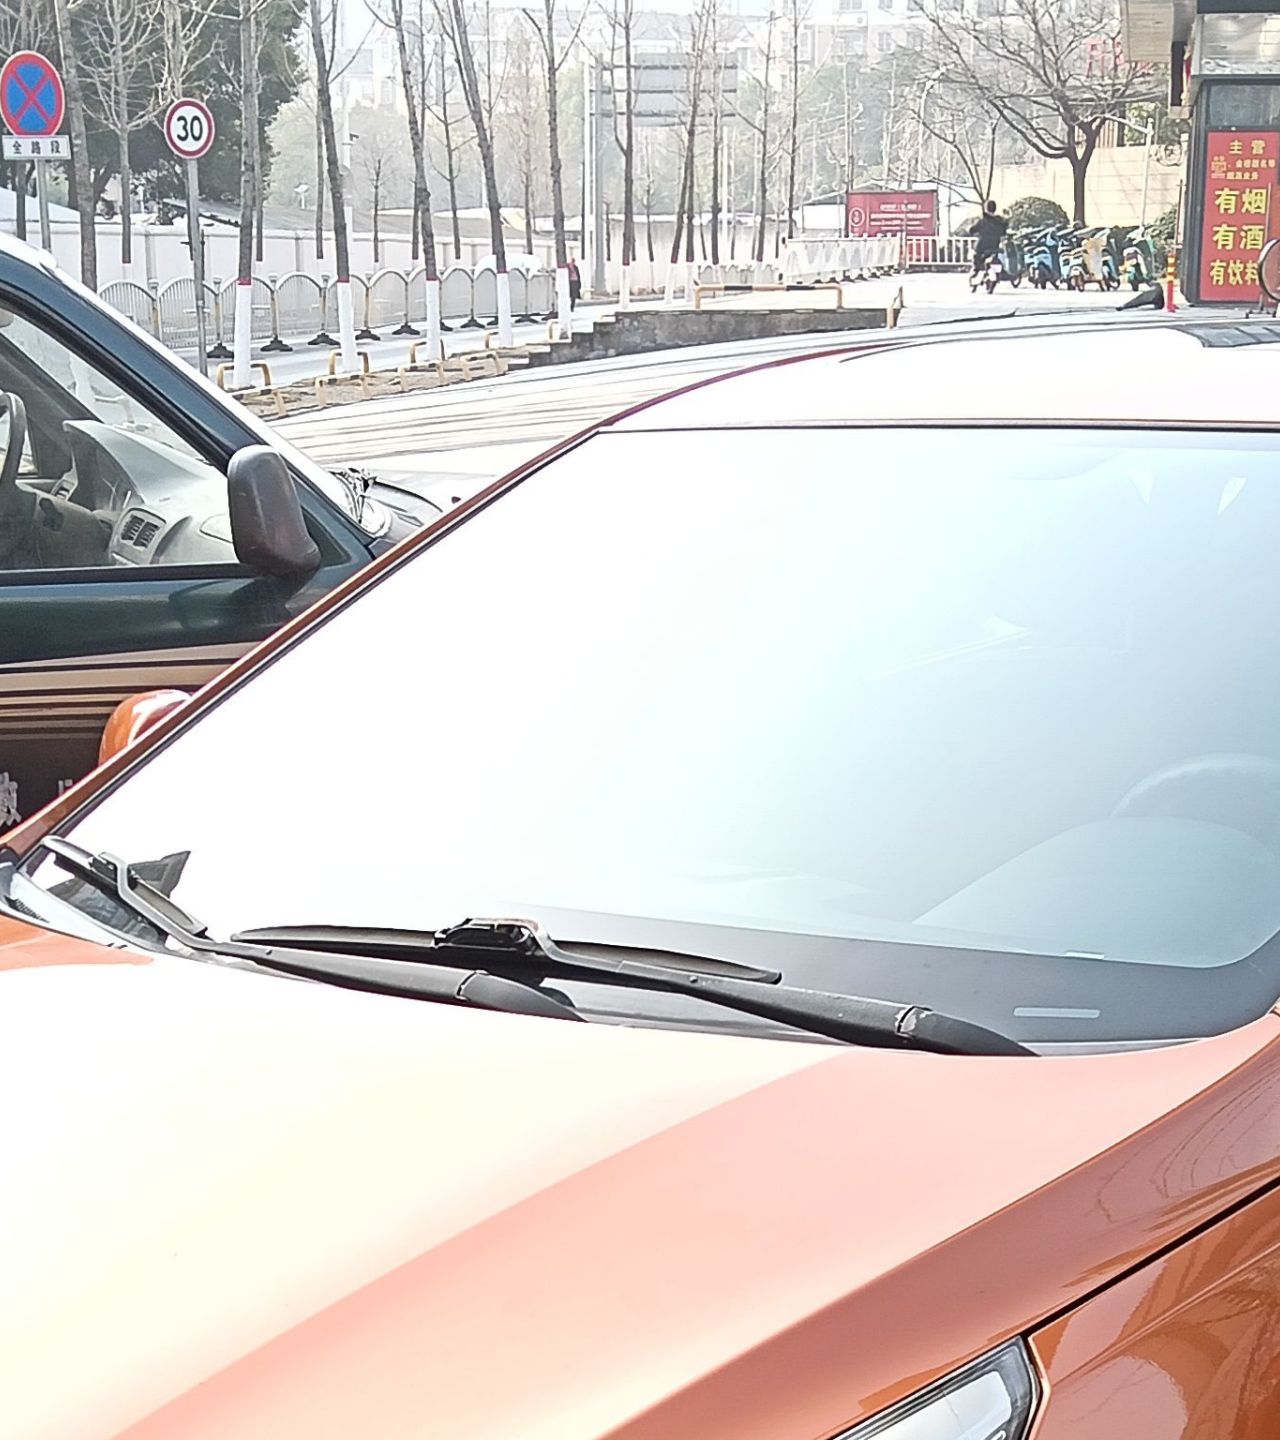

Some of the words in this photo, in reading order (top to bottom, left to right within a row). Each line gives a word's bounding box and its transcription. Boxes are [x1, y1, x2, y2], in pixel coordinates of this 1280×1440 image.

[177, 115, 203, 141] 30
[12, 140, 61, 155] 全路段
[1214, 187, 1267, 214] 有烟
[1212, 223, 1265, 250] 有酒
[1209, 259, 1261, 286] 有饮料
